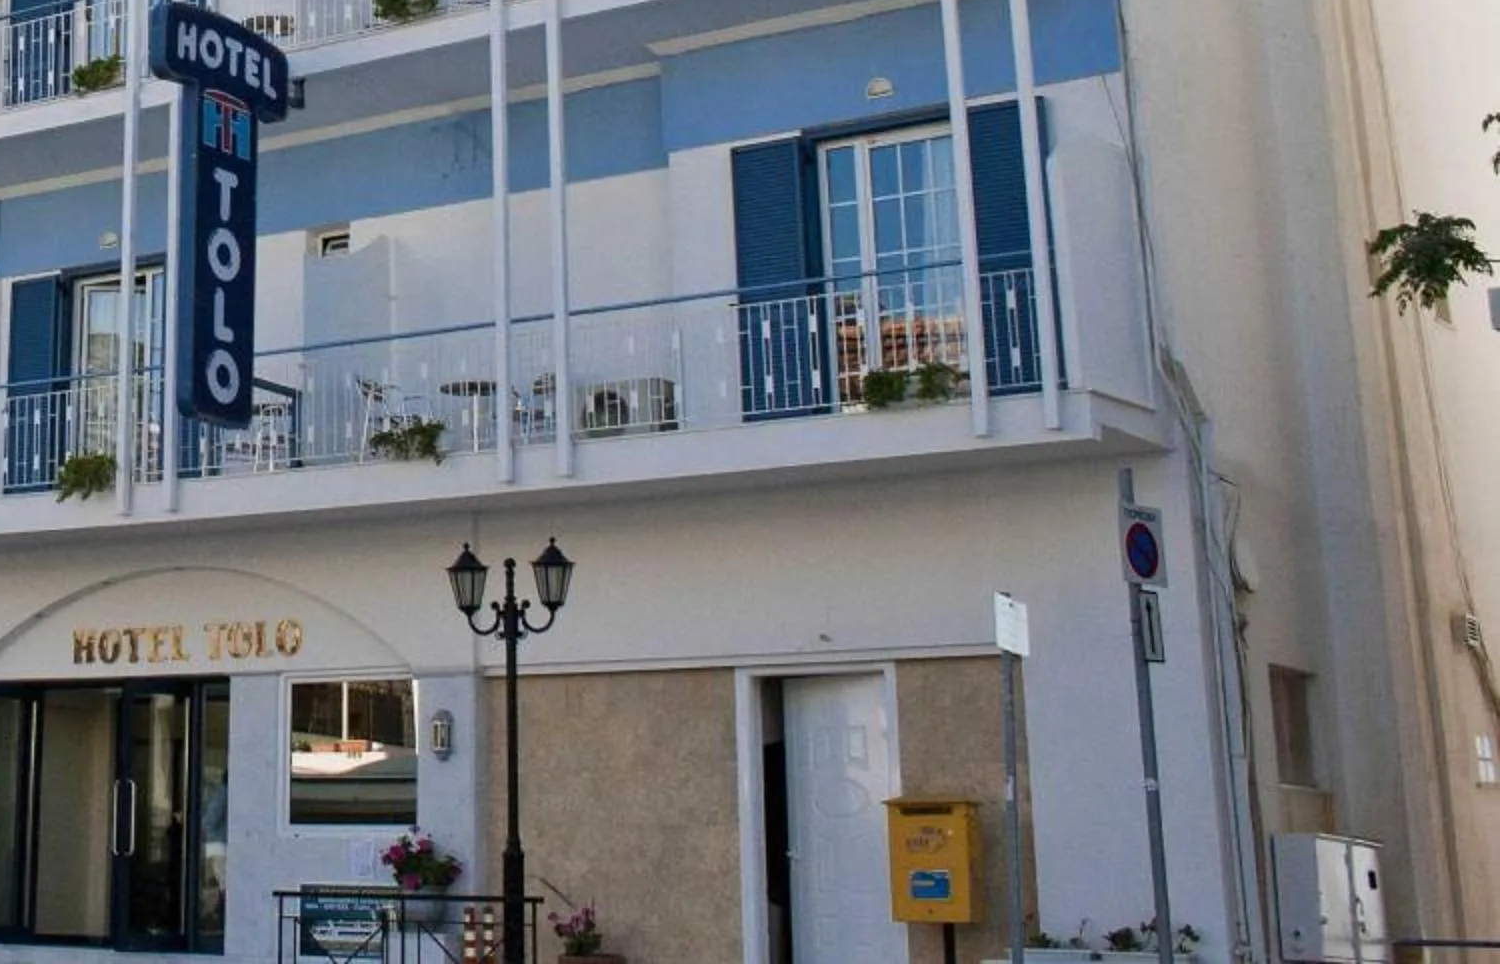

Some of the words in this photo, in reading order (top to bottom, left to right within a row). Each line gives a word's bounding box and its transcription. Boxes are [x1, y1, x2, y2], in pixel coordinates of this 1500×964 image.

[177, 21, 278, 100] HOTEL
[206, 167, 241, 405] TOLO
[73, 624, 190, 664] HOTEL
[203, 618, 304, 661] TOLO
